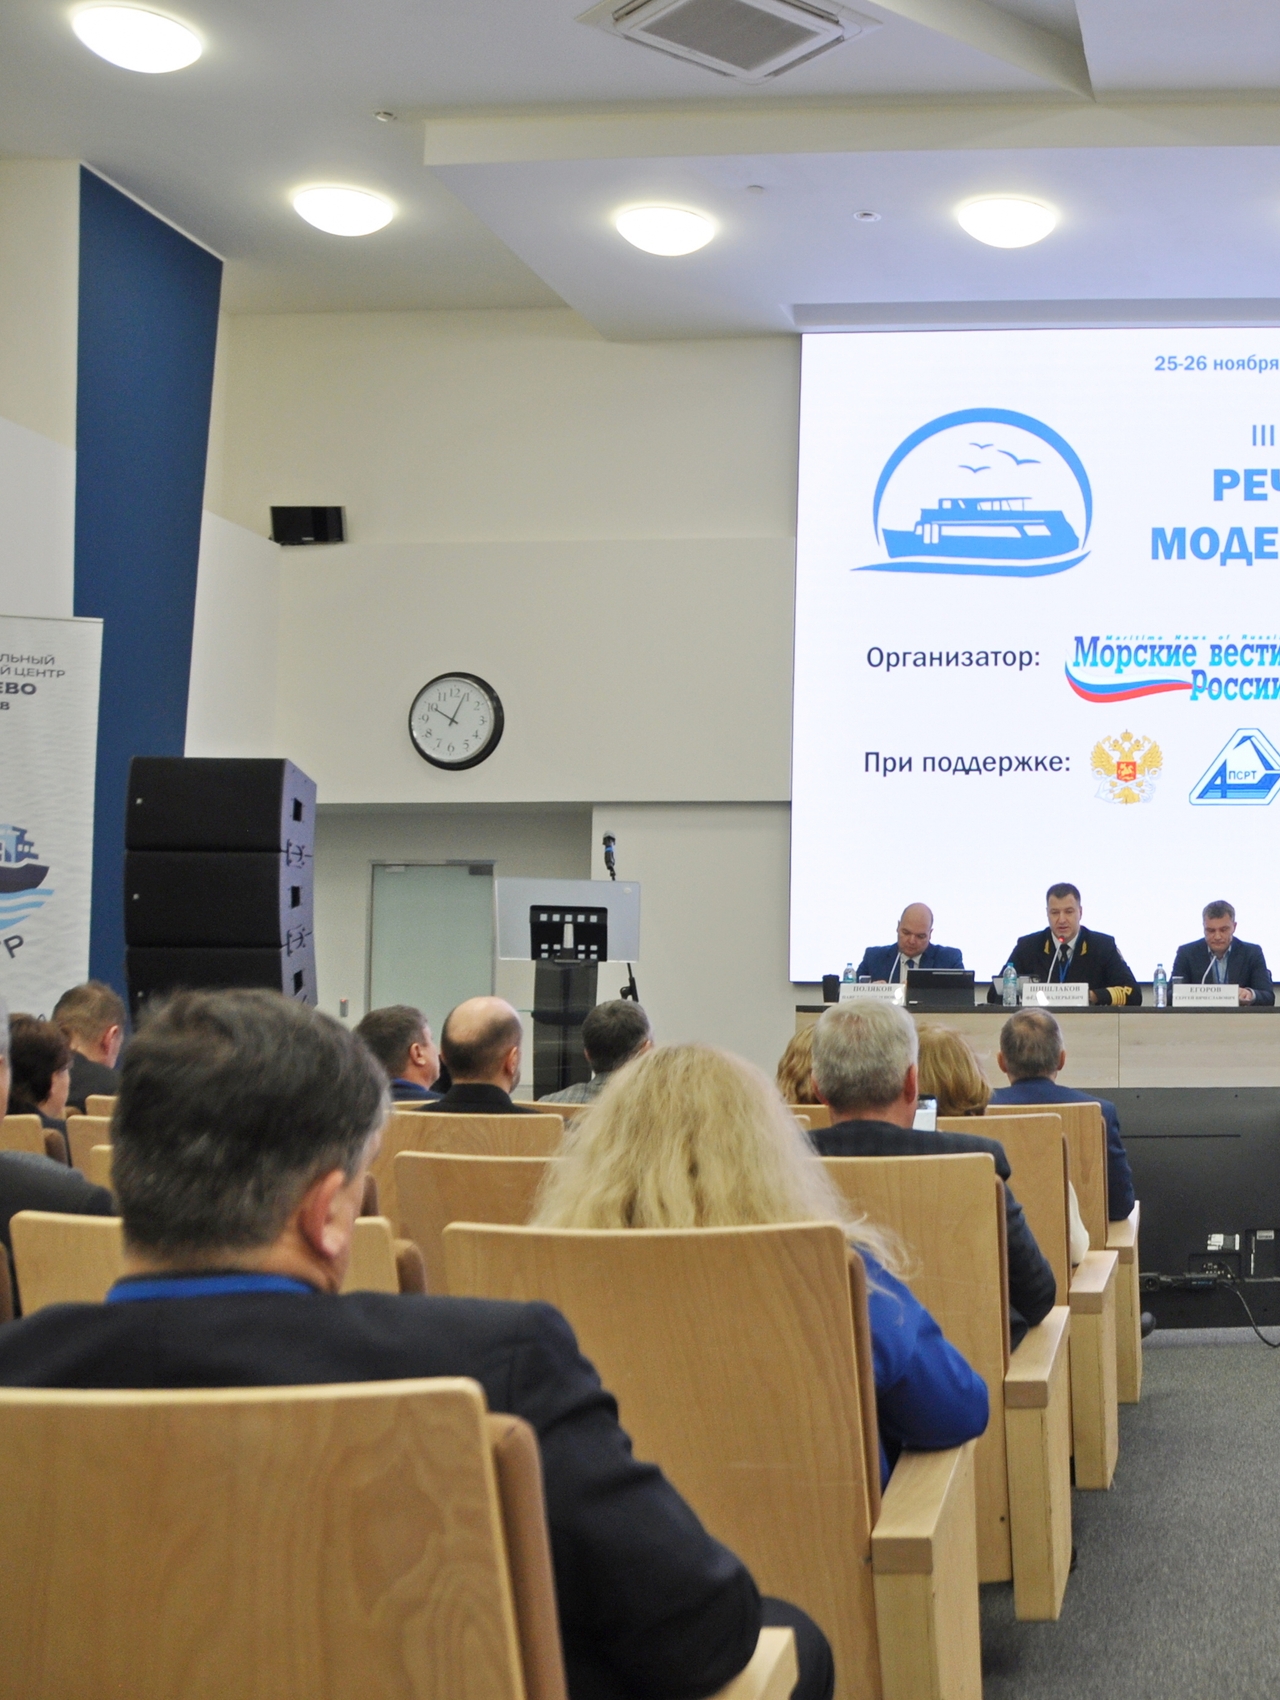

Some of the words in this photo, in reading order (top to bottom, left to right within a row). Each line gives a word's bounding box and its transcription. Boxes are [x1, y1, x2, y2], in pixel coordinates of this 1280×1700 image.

[1154, 354, 1208, 371] 25-26
[1213, 354, 1280, 374] ноября
[1252, 424, 1276, 447] III
[1105, 633, 1164, 642] Maritime
[1174, 633, 1208, 642] News
[1218, 633, 1231, 642] of
[866, 646, 1040, 673] Организатор:
[1073, 636, 1197, 674] Морские
[14, 667, 66, 678] ЦЕНТР
[864, 751, 913, 778] При
[922, 755, 1071, 778] поддержке:
[0, 934, 24, 959] Р
[1189, 985, 1222, 993] ЕГОРОВ
